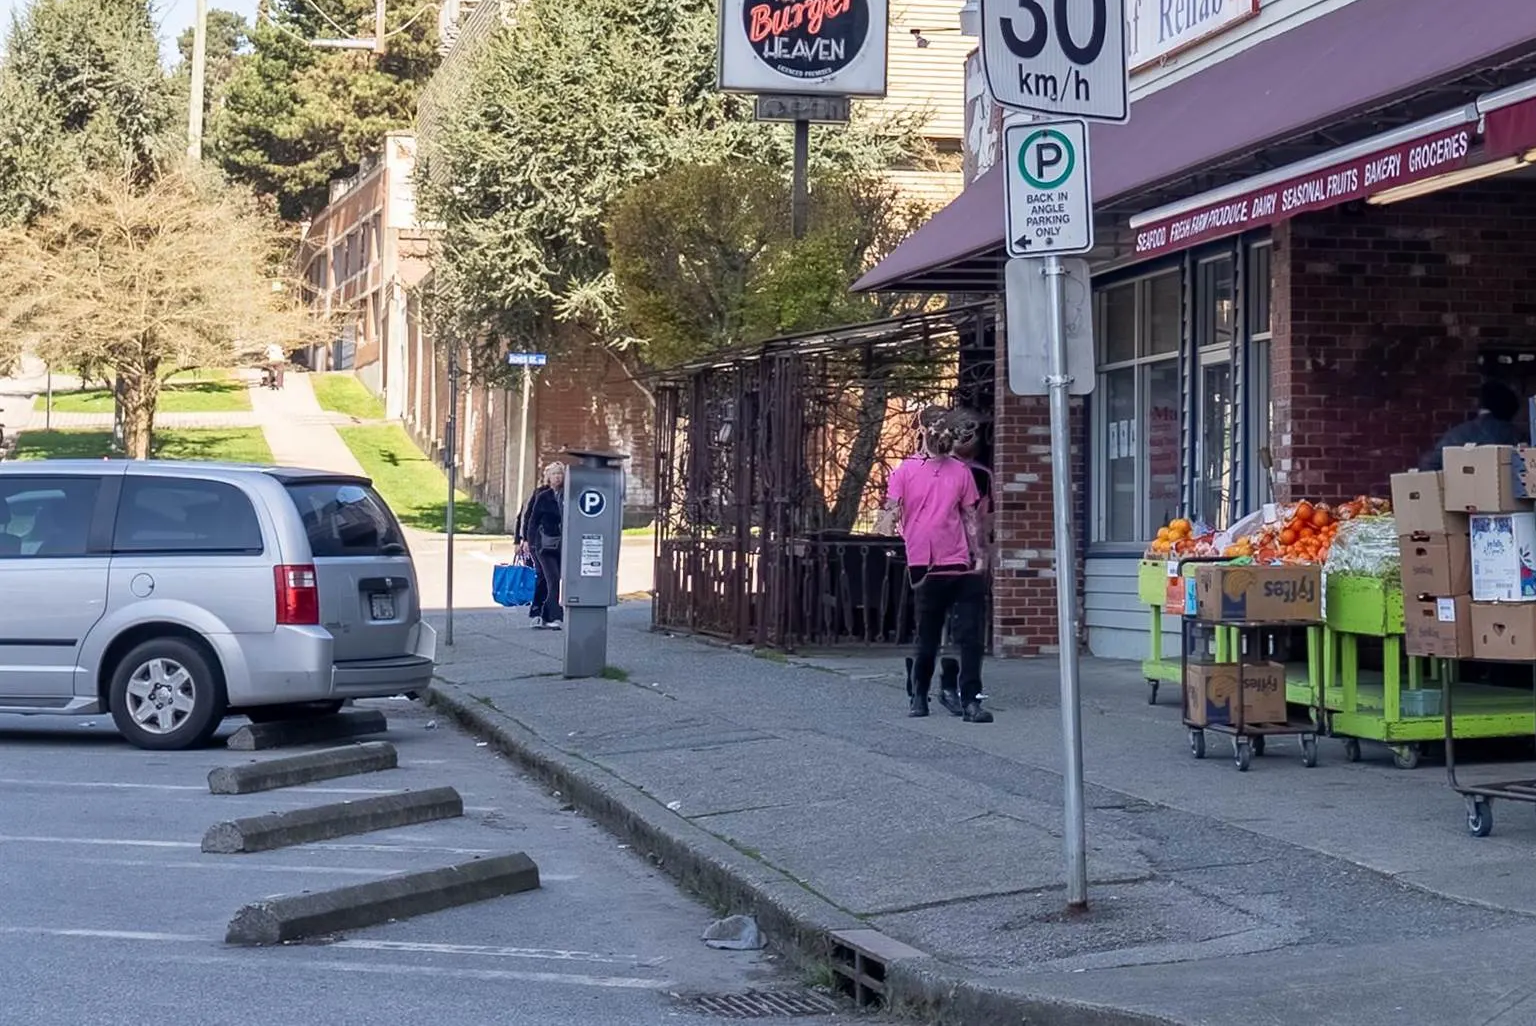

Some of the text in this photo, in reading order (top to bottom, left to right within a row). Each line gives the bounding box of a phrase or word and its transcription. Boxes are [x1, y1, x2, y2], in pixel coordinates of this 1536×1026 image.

[763, 37, 845, 61] HEAVEN
[1019, 63, 1090, 102] km/h
[1036, 142, 1062, 179] P
[1026, 191, 1069, 204] BACK IN
[1136, 226, 1166, 252] SEAFOOD
[1207, 200, 1248, 229] PRODUCE
[1251, 193, 1277, 220] DAIRY
[1282, 180, 1326, 213] SEASONAL
[1326, 169, 1358, 198] FRUITS
[1364, 152, 1401, 187] BAKERY
[1408, 131, 1468, 173] GROCERIES
[1031, 203, 1065, 215] ANGLE
[1026, 214, 1070, 227] PARKING
[1036, 226, 1062, 237] ONLY
[585, 493, 600, 513] P
[1263, 576, 1315, 603] fyffes
